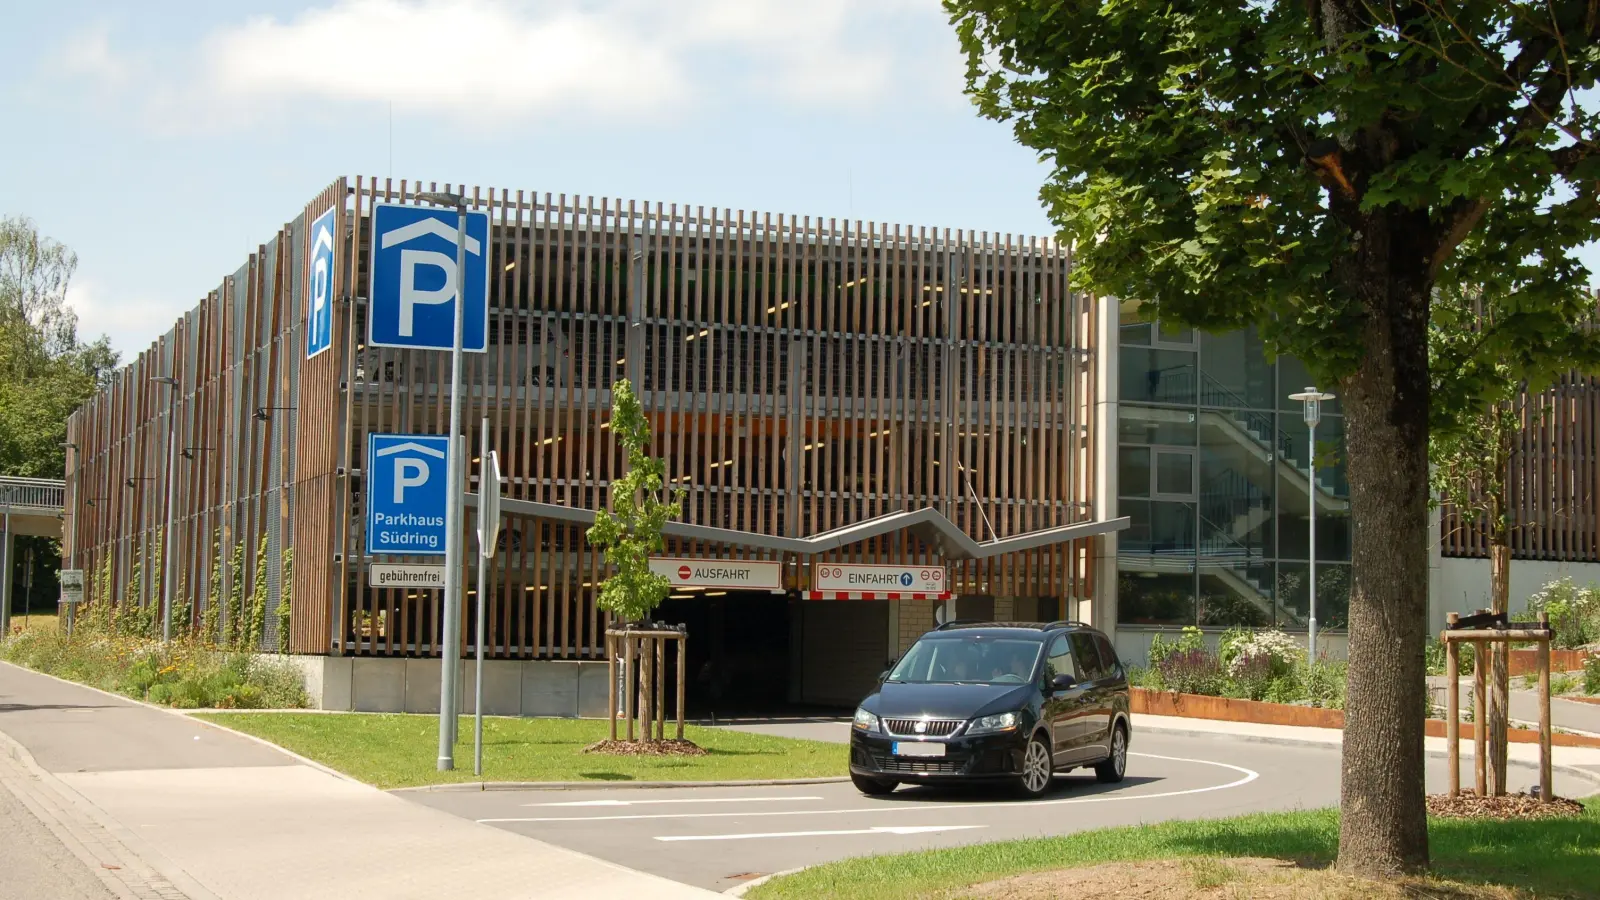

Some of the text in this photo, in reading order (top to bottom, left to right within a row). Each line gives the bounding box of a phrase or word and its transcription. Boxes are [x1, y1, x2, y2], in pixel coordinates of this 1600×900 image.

[398, 249, 457, 337] P
[312, 258, 327, 345] P
[393, 457, 430, 504] P
[375, 512, 444, 526] Parkhaus
[380, 531, 438, 548] Südring
[380, 570, 440, 584] gebührenfrei
[694, 568, 751, 580] AUSFAHRT
[848, 573, 900, 585] EINFAHRT
